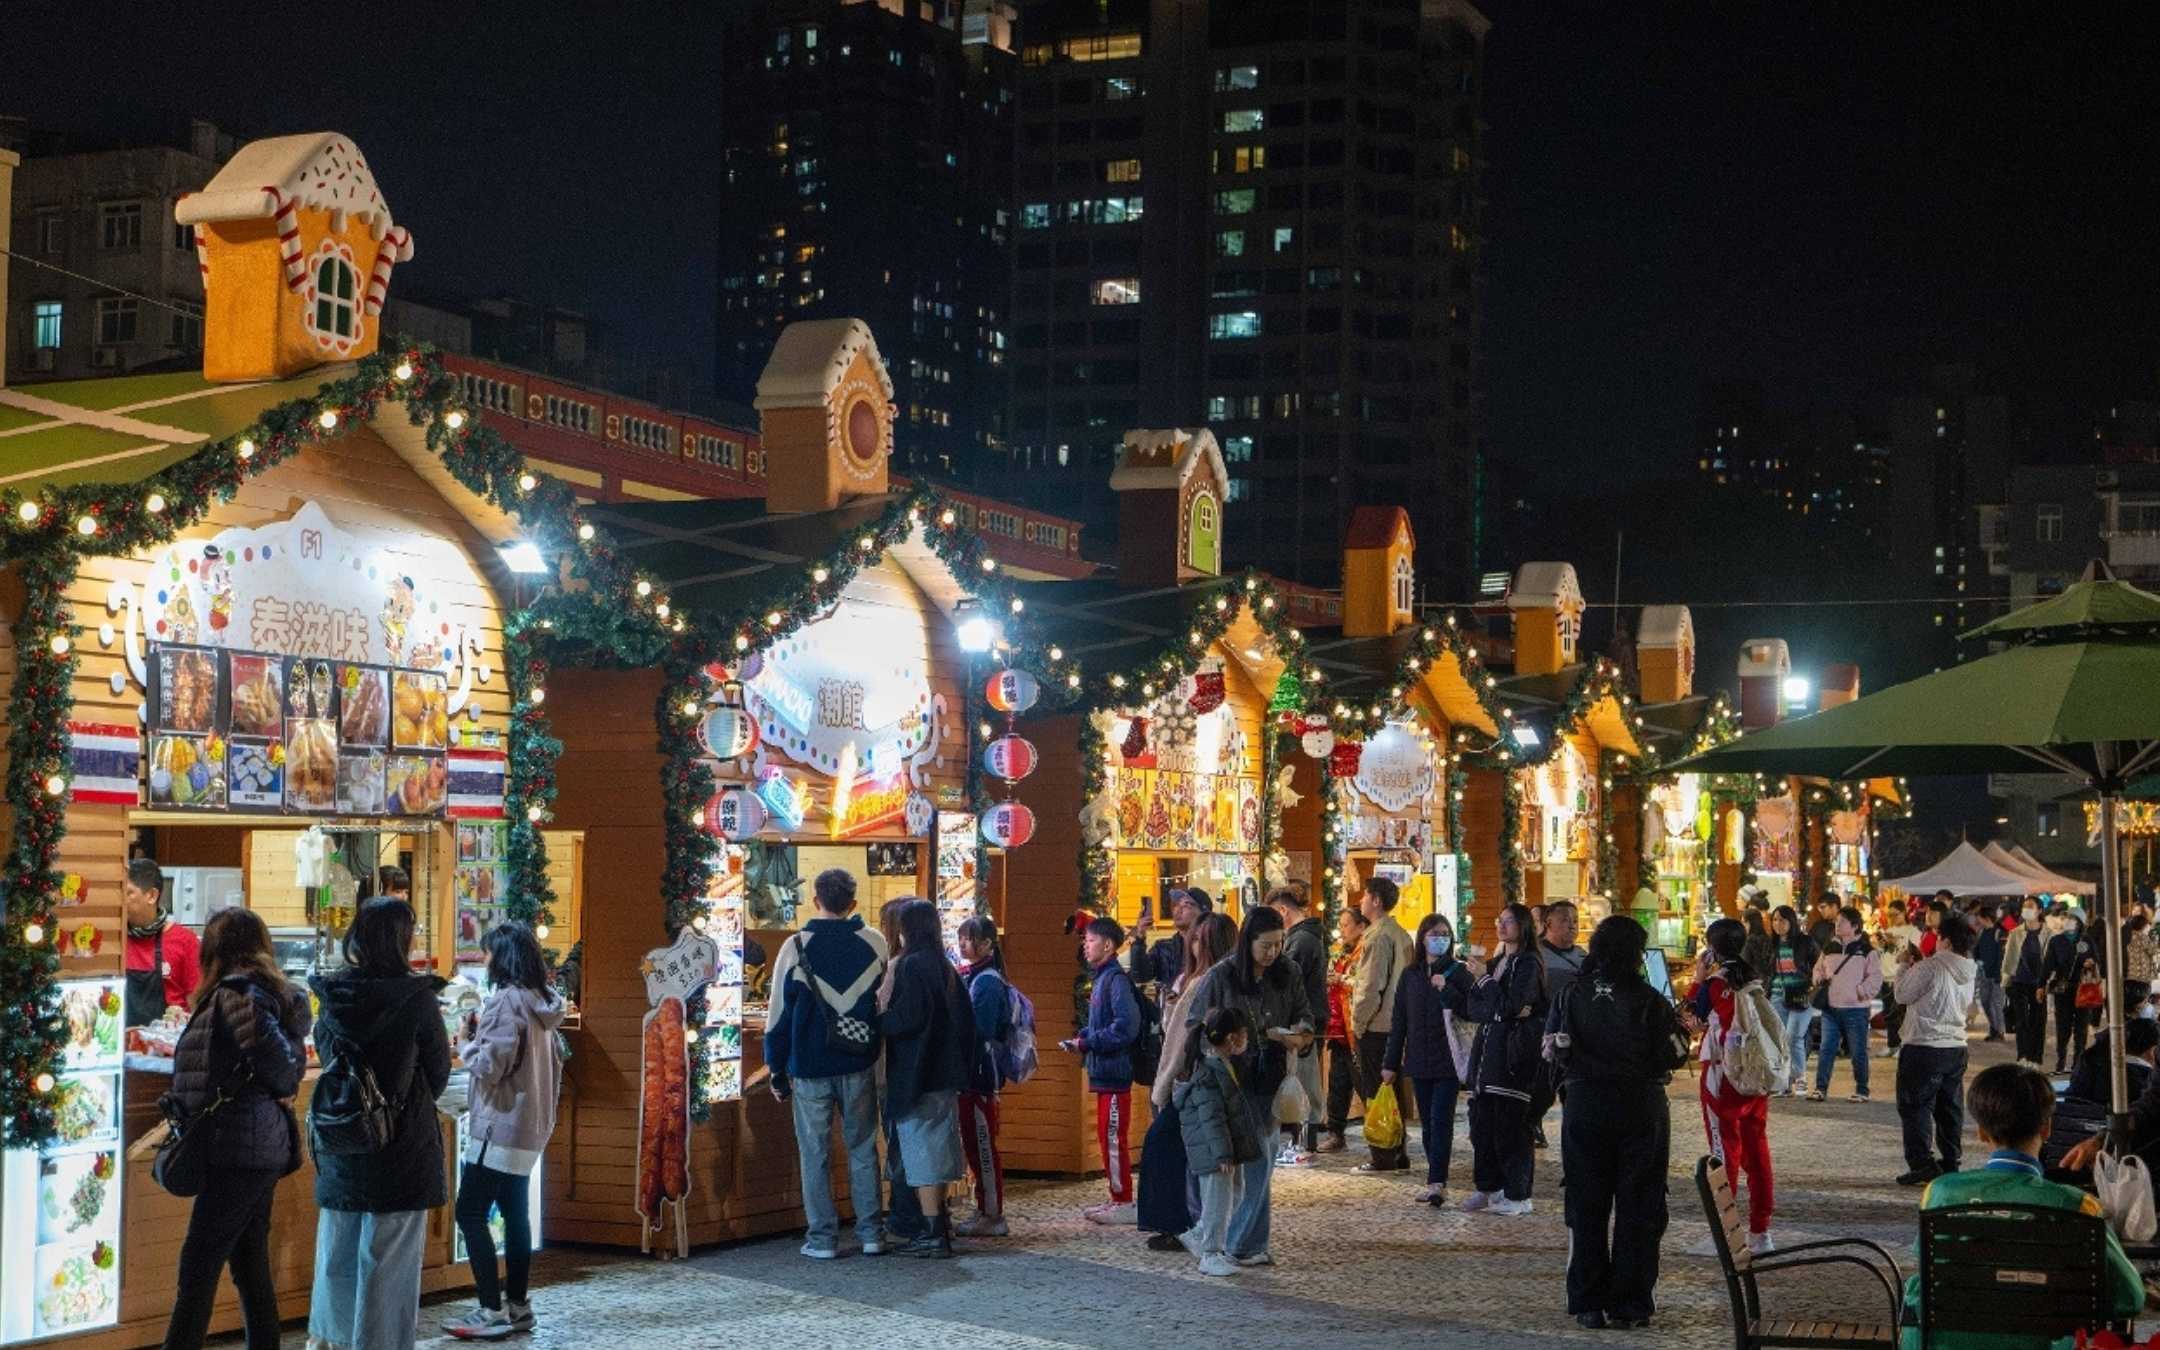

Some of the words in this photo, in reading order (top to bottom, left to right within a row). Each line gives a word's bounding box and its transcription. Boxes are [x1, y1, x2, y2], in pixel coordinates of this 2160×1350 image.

[300, 528, 322, 560] F1
[251, 596, 370, 662] 泰滋味
